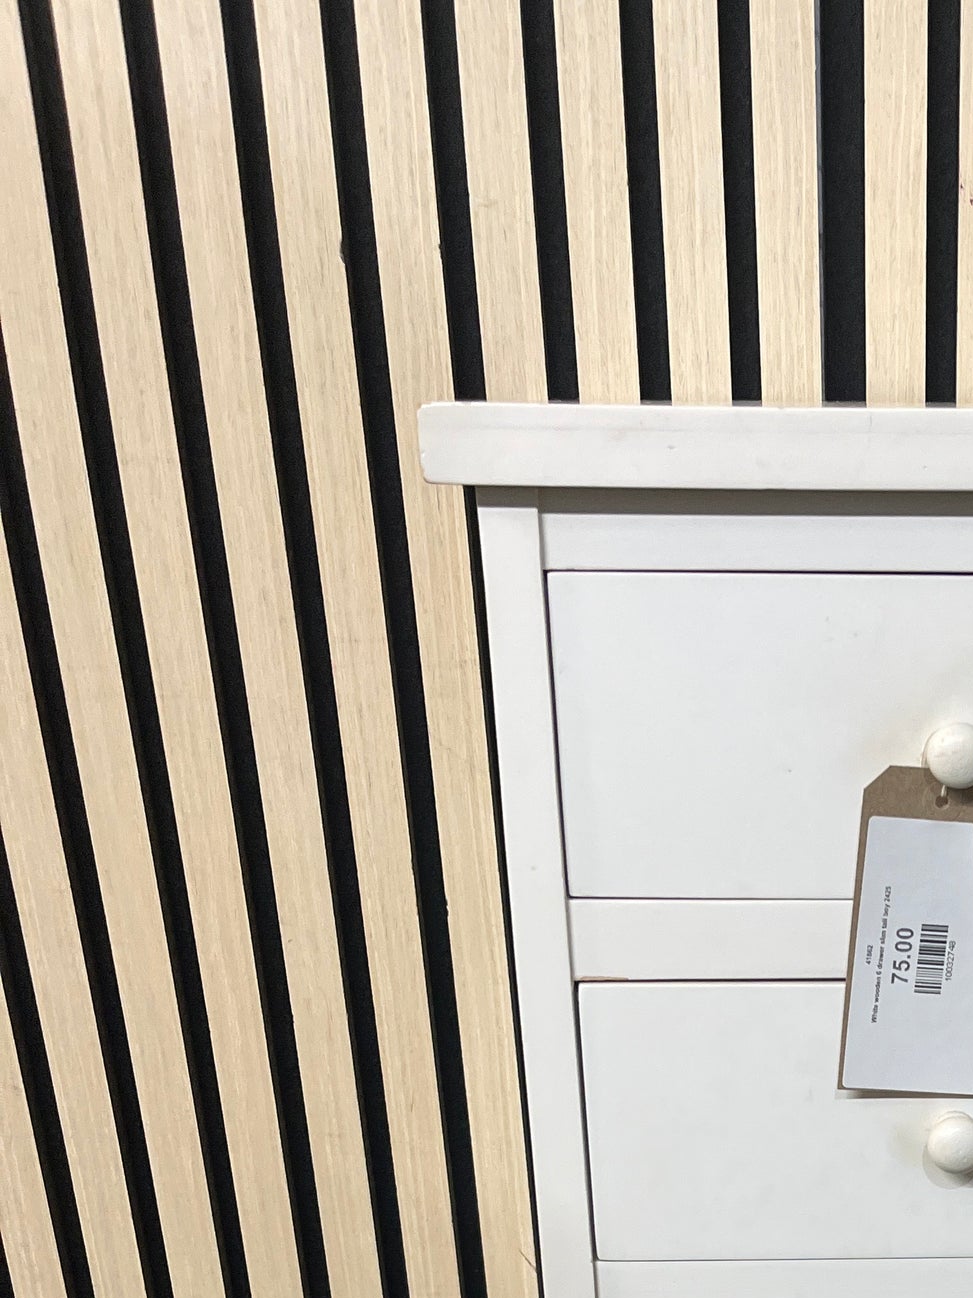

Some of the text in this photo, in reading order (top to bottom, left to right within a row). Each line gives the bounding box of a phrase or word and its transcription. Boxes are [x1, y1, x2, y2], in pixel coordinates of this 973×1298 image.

[883, 904, 891, 917] boy
[880, 918, 888, 929] tall
[877, 946, 885, 969] drawer
[891, 927, 914, 984] 75.00
[945, 940, 956, 981] 10032748
[873, 976, 882, 1003] wooden
[871, 1004, 879, 1024] White
